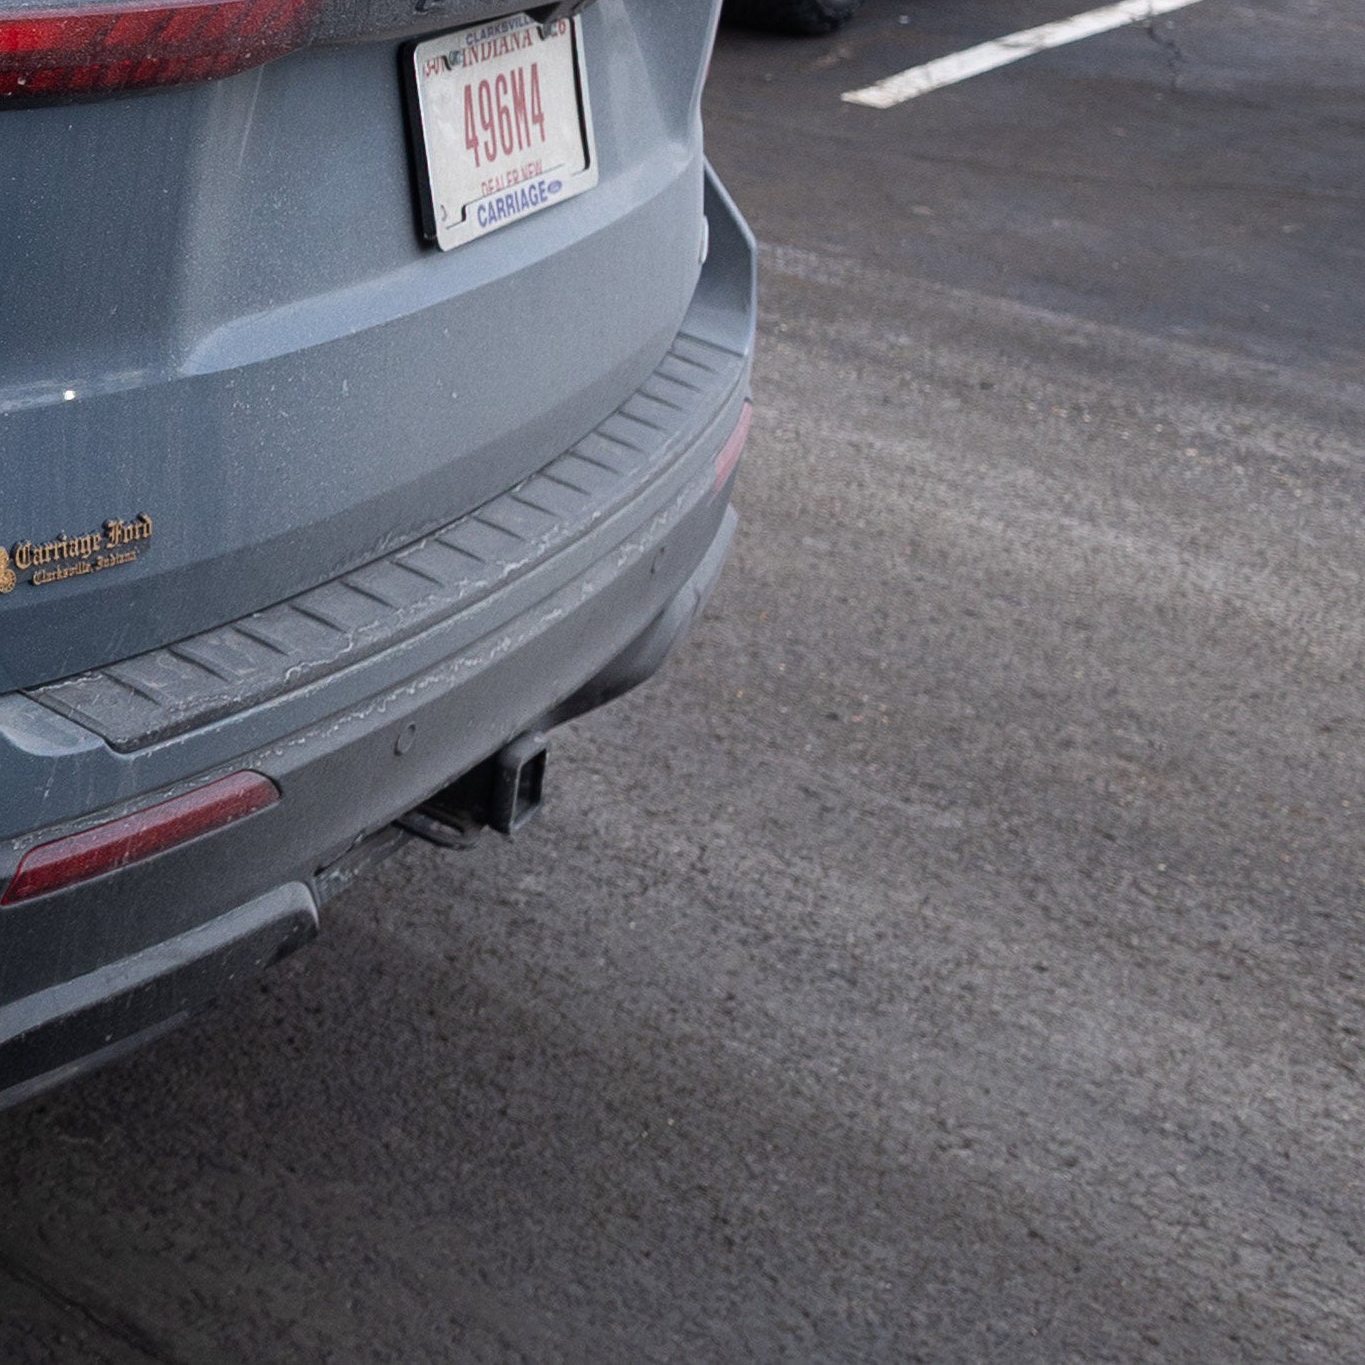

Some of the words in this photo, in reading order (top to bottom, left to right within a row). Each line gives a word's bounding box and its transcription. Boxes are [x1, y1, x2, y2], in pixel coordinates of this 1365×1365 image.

[461, 31, 534, 68] INDIANA
[466, 15, 536, 45] CLARKSVILL
[464, 62, 546, 168] 496M4
[477, 180, 548, 227] CARRIAGE
[481, 168, 519, 197] DEALER
[13, 530, 102, 570] Carriage
[103, 512, 154, 549] Ford
